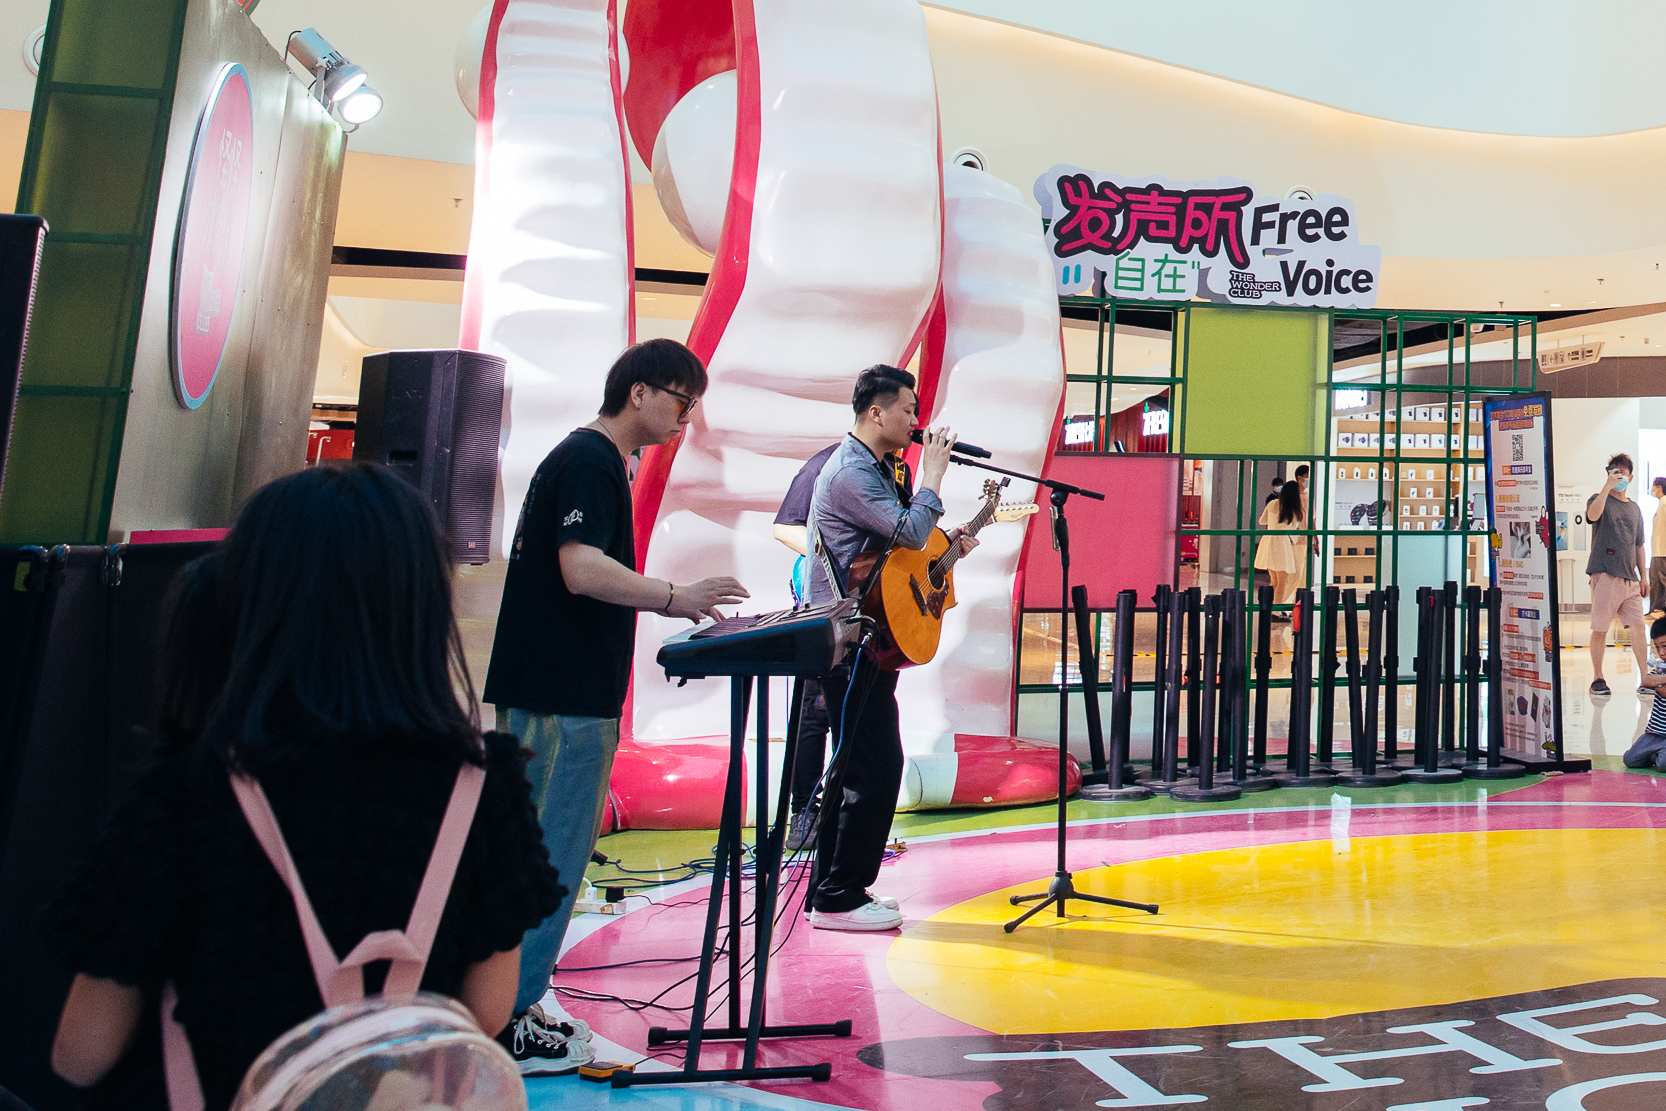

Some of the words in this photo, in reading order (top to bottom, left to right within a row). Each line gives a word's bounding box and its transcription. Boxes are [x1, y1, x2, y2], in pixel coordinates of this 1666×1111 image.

[1059, 177, 1250, 266] 发声所
[1250, 203, 1350, 247] Free
[1230, 271, 1254, 281] THE
[1230, 280, 1280, 291] WONDER
[1279, 258, 1374, 298] Voice
[1230, 289, 1261, 298] CLUB
